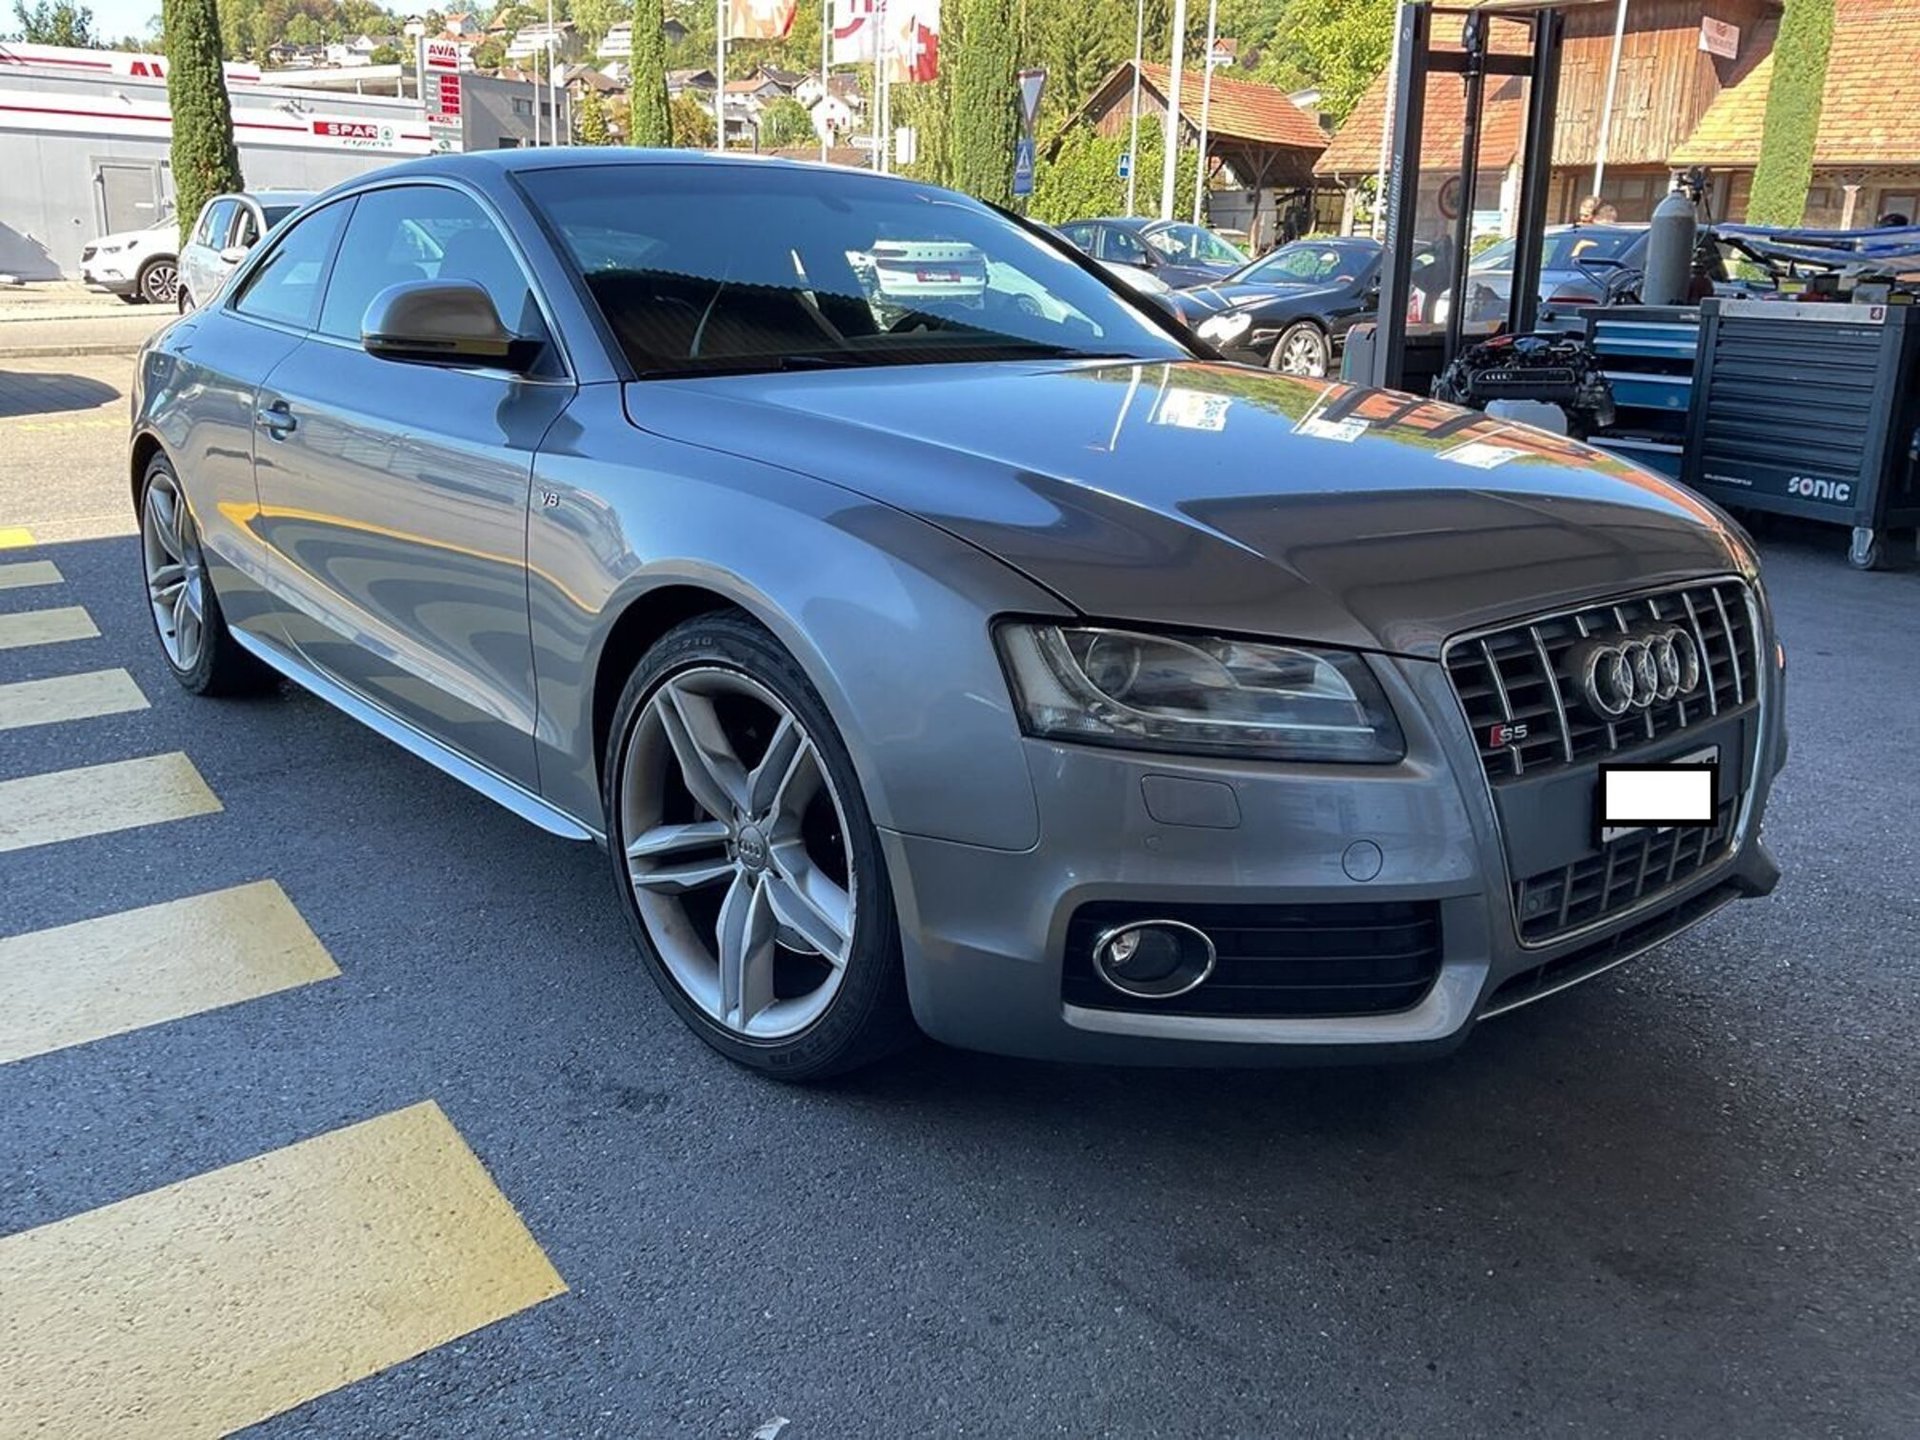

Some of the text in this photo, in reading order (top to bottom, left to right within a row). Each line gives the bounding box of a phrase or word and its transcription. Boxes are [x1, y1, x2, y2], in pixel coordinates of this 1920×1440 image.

[327, 123, 378, 138] SPAR
[540, 491, 558, 507] V8
[1500, 724, 1528, 742] S5
